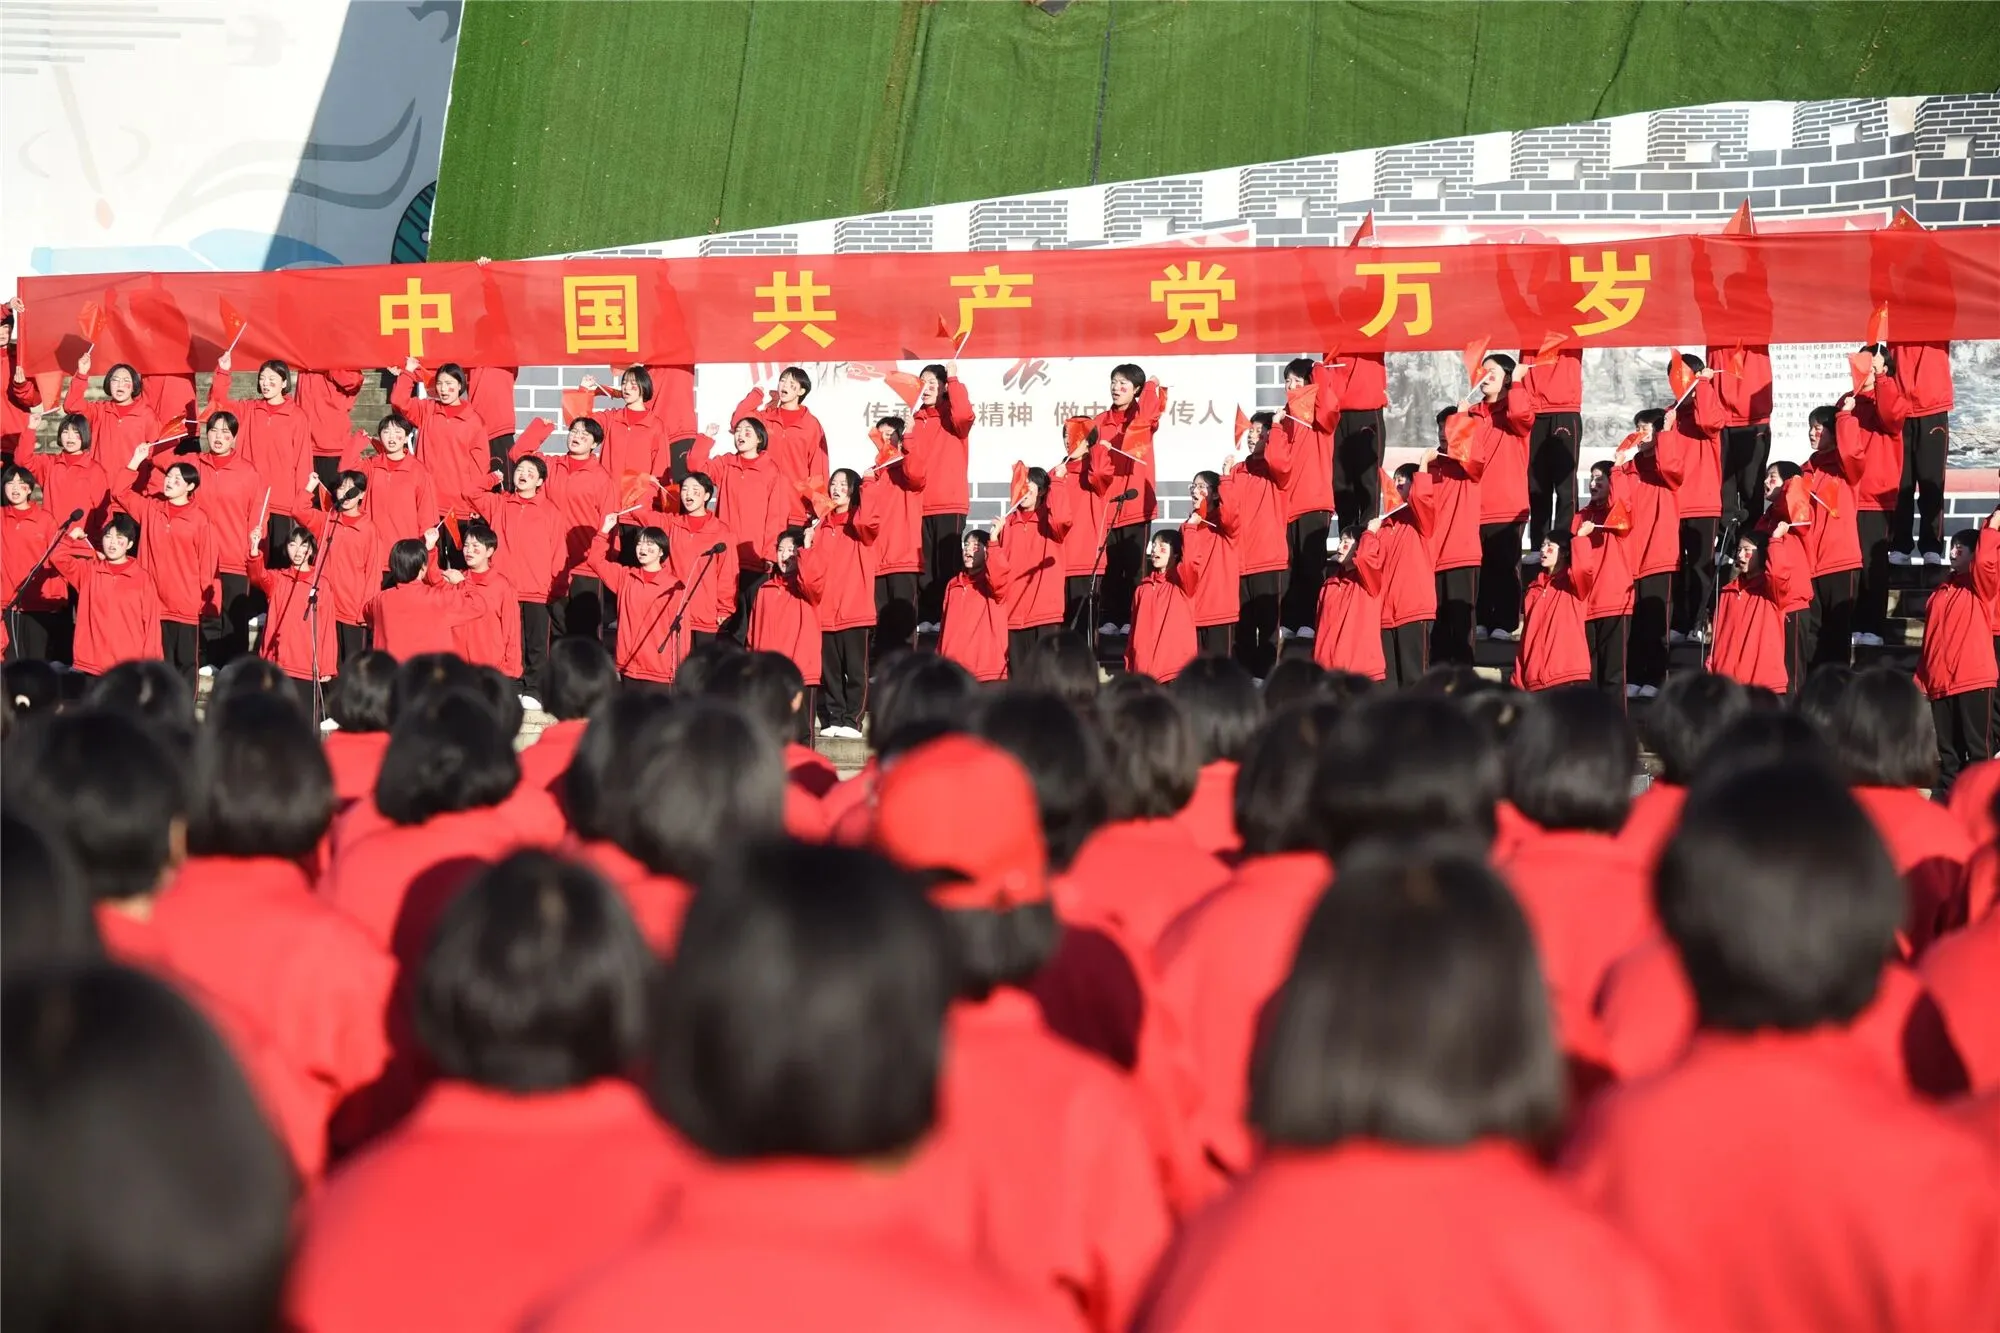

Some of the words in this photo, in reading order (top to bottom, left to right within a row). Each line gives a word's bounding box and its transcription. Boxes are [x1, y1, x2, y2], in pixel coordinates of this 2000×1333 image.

[379, 251, 1652, 357] 中国共产党万岁
[863, 402, 1034, 427] 传承精神
[1053, 400, 1223, 426] 做中传人
